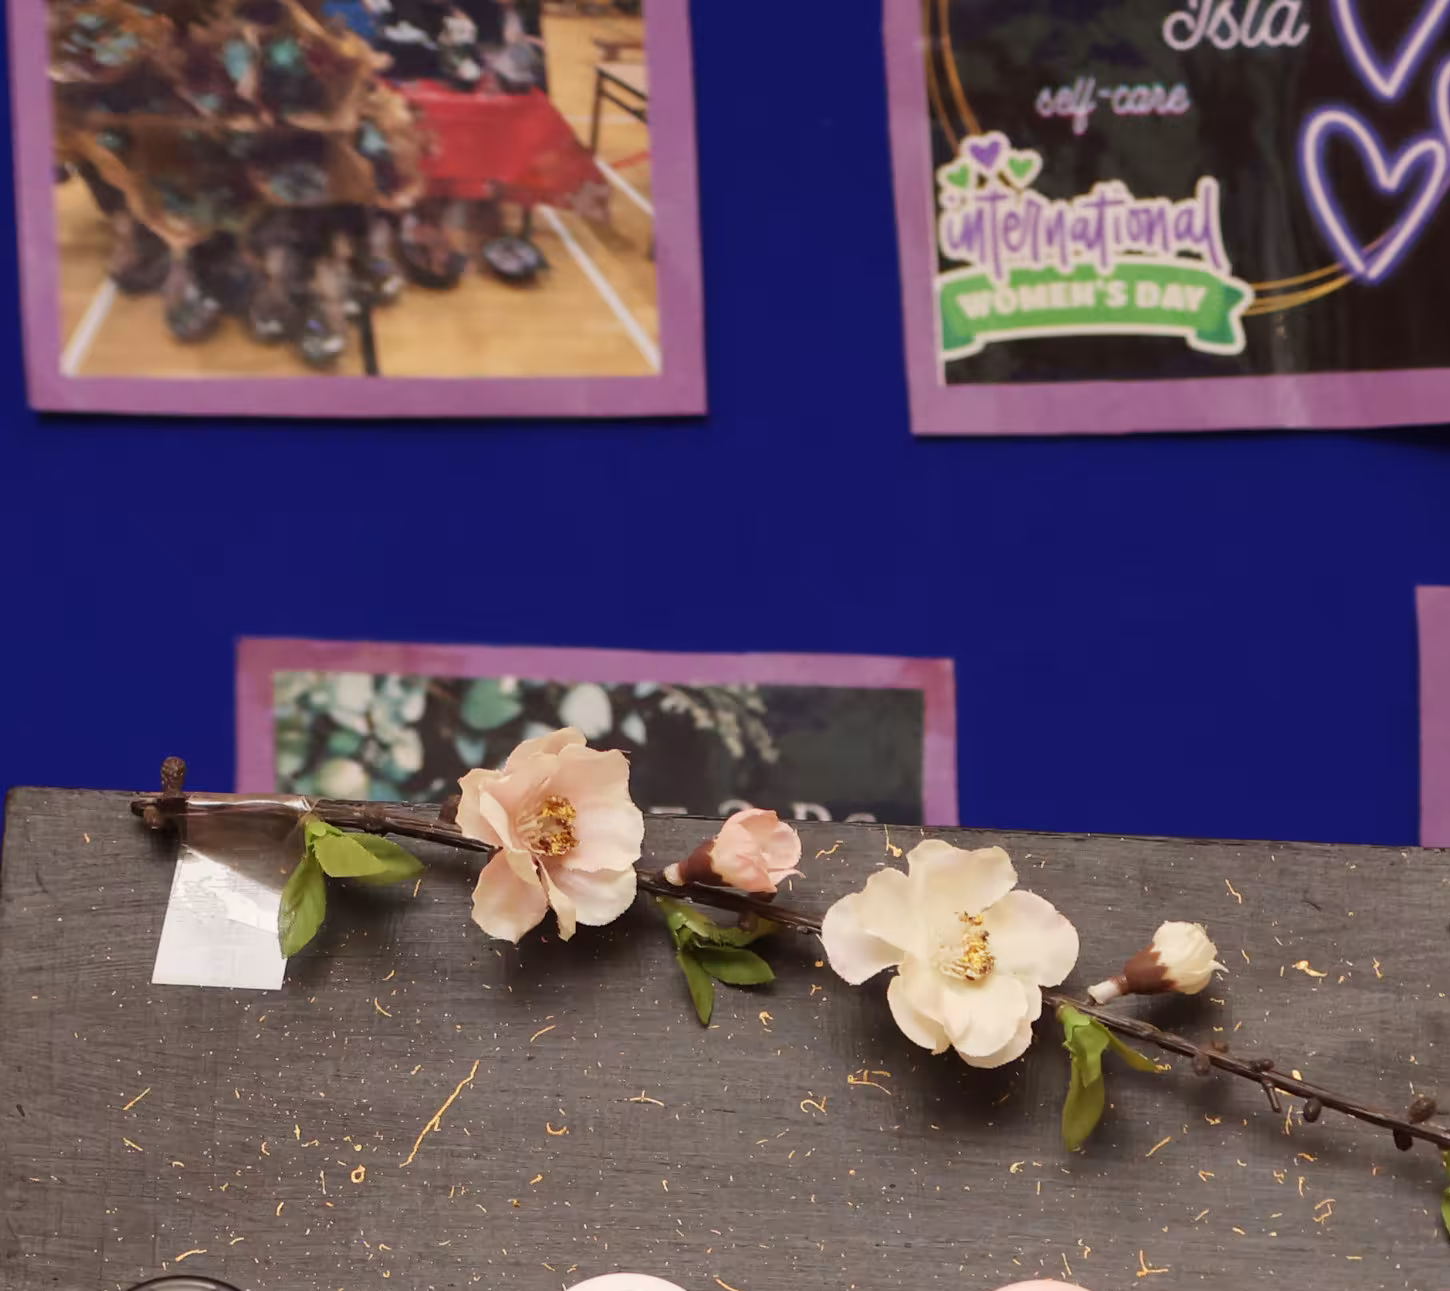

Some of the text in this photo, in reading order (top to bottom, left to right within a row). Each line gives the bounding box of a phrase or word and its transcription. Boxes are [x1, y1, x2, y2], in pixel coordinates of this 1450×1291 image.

[1035, 77, 1190, 134] self-care
[941, 181, 1224, 280] international
[956, 281, 1208, 321] WOMEN'S DAY
